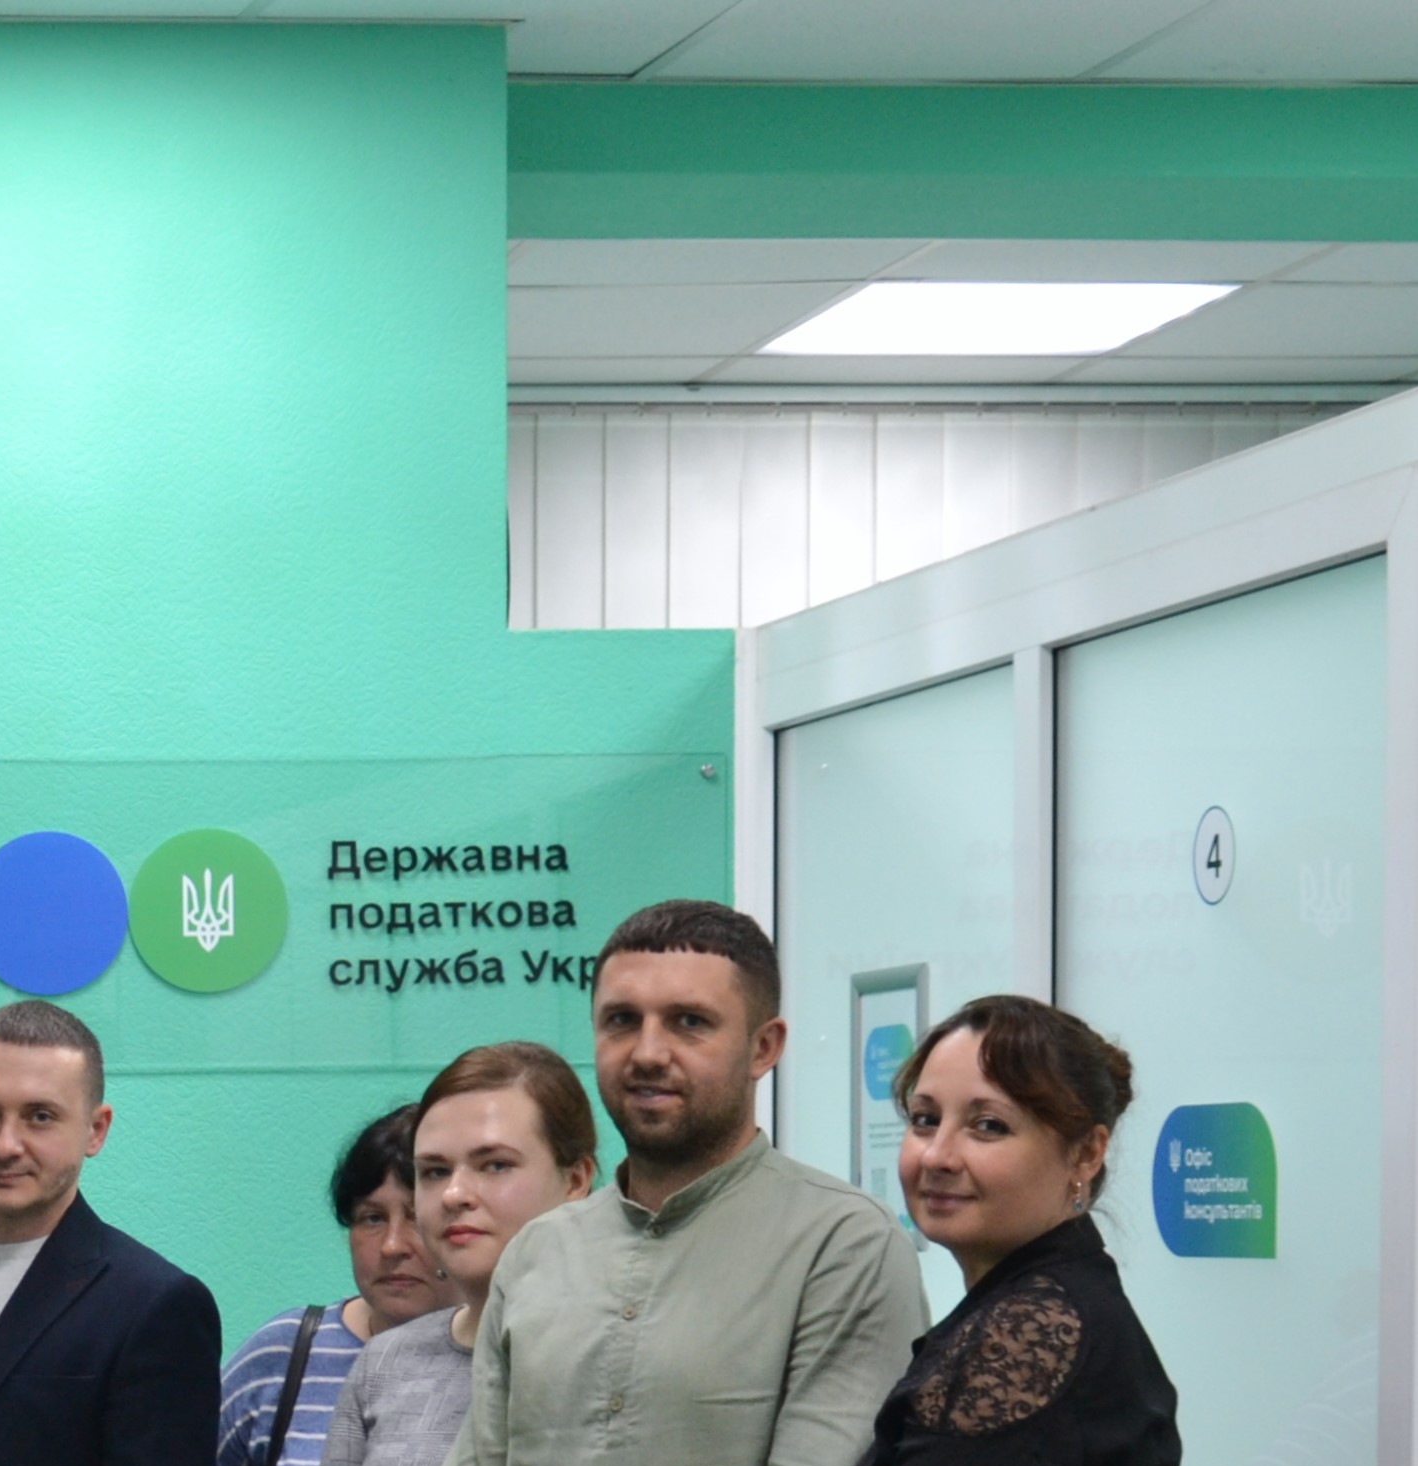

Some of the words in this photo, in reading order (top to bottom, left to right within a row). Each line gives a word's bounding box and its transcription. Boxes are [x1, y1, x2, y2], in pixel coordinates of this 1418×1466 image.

[327, 840, 569, 881] Державна
[1206, 833, 1223, 879] 4
[329, 899, 577, 935] податкова
[328, 949, 505, 993] служба
[521, 949, 597, 990] Укр
[1184, 1147, 1213, 1170] Офіс
